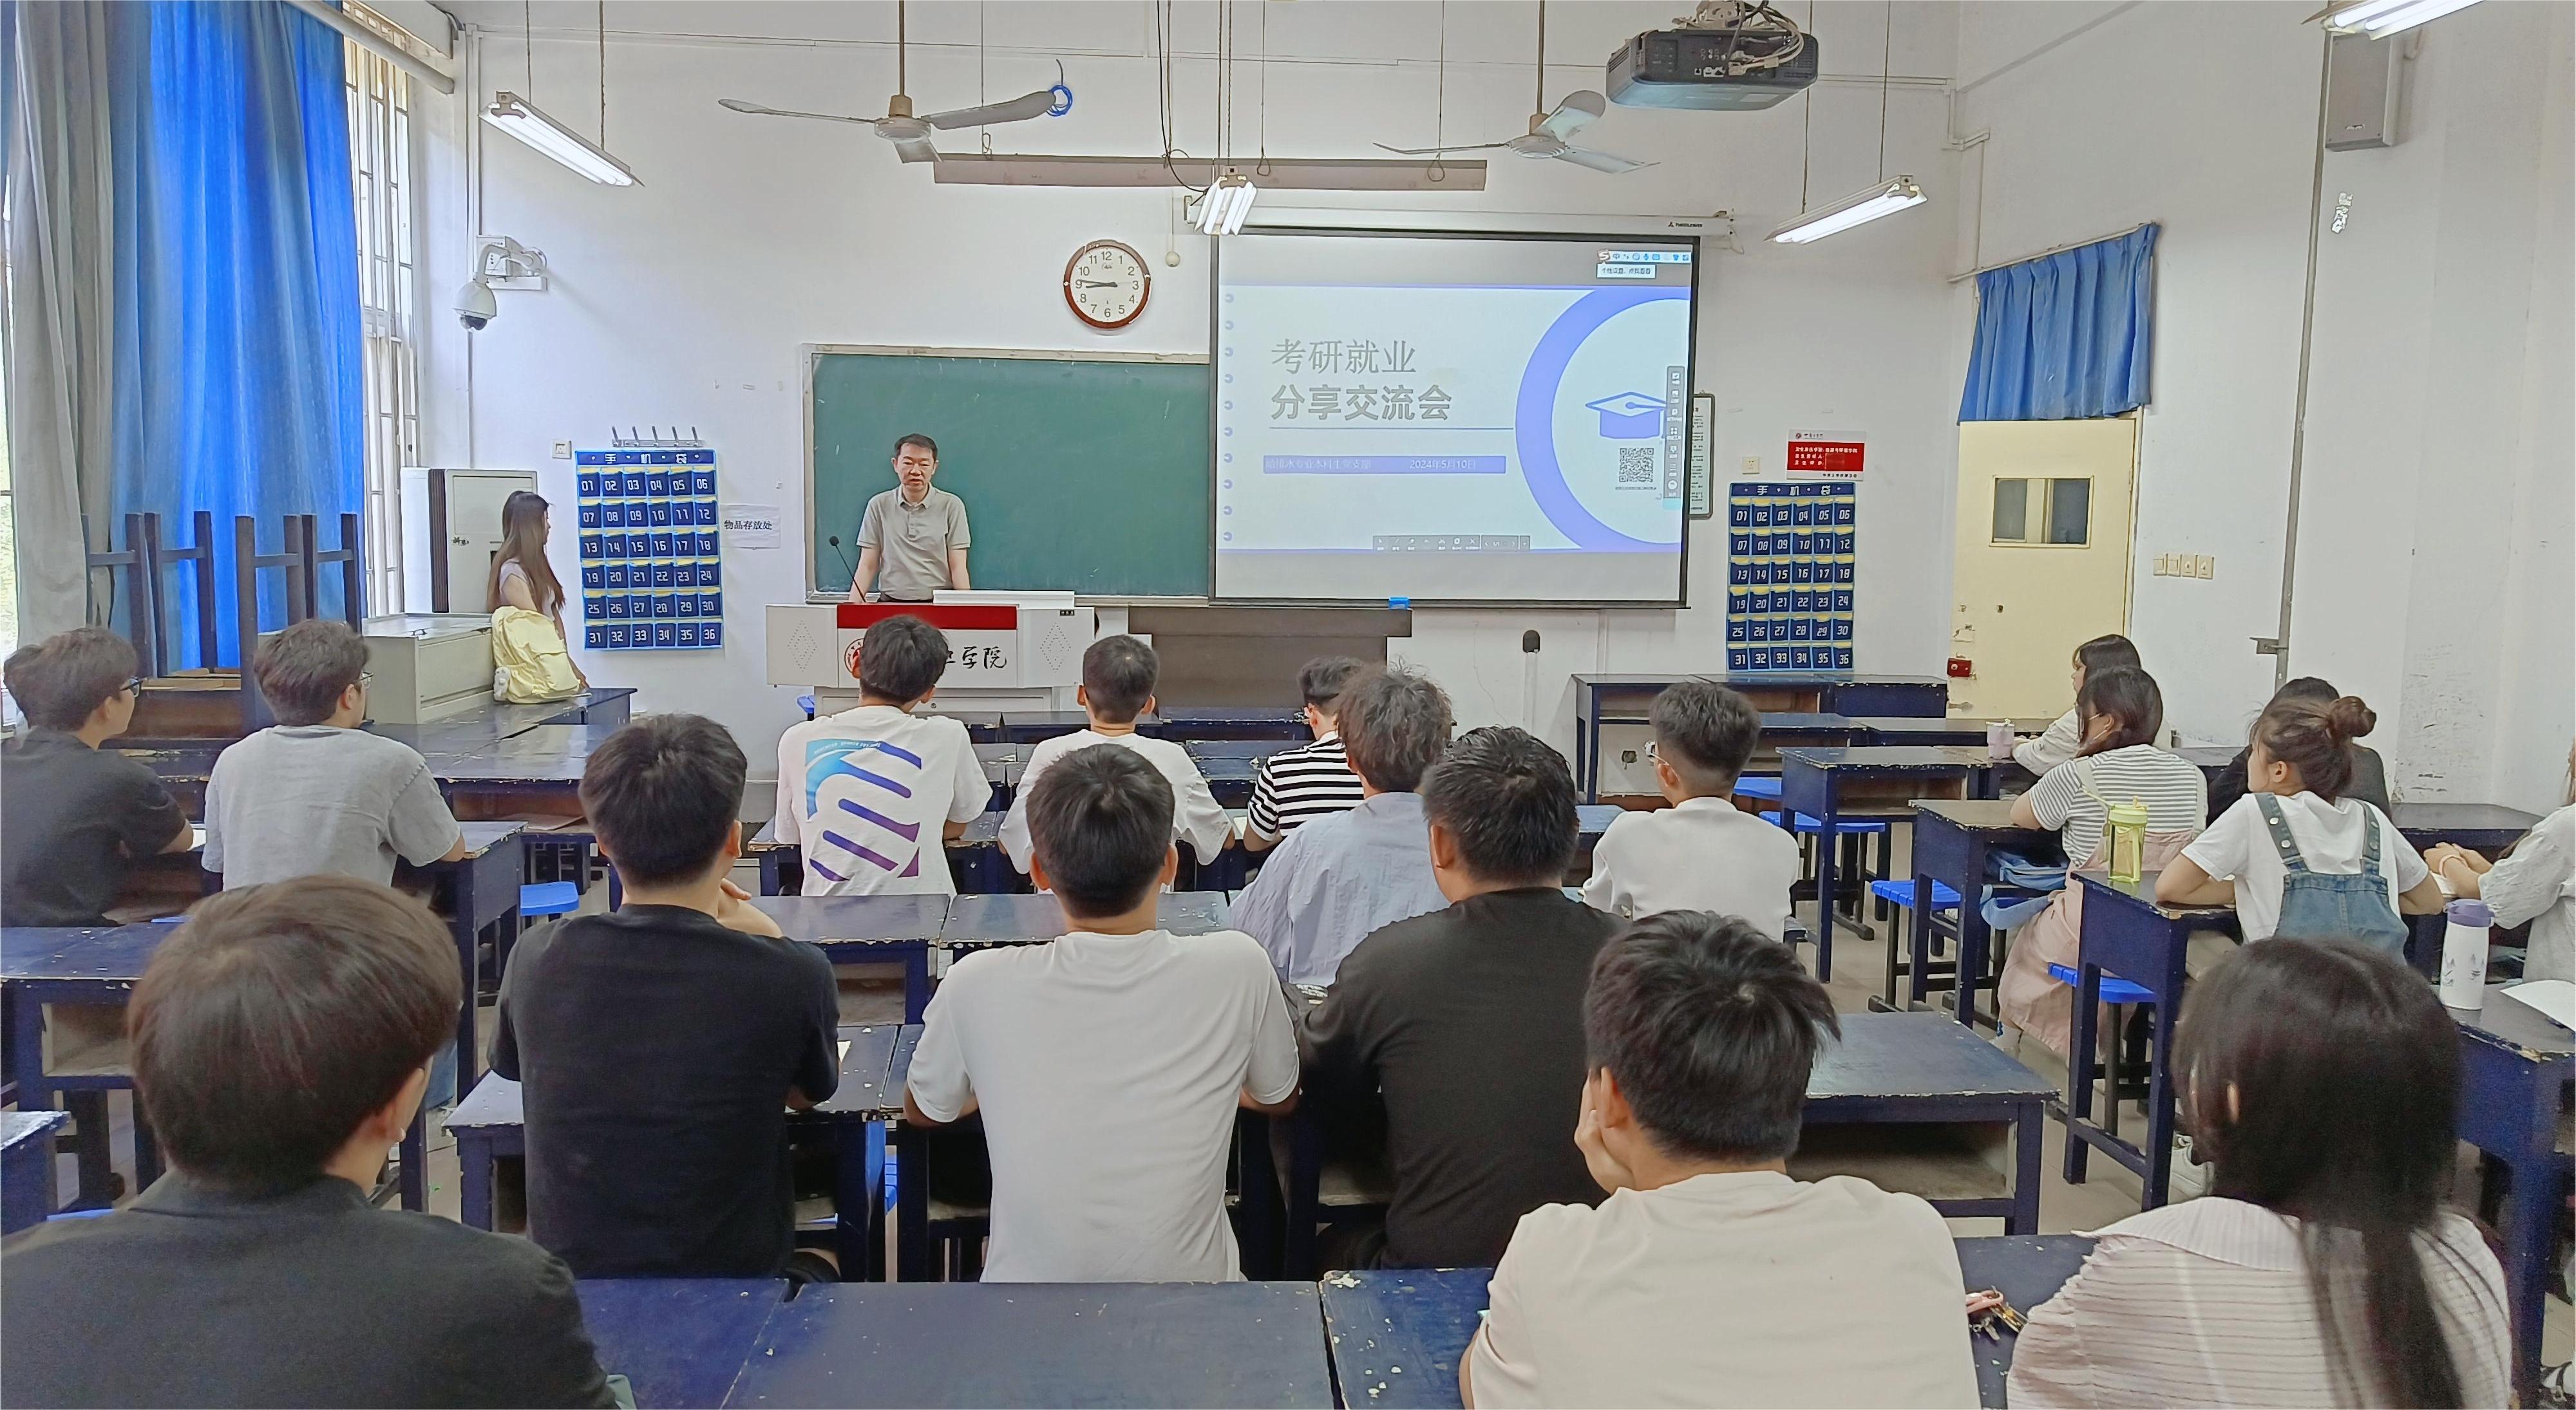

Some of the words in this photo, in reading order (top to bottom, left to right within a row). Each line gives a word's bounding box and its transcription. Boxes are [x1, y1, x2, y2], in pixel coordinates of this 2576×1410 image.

[1089, 255, 1097, 264] 11
[1101, 251, 1112, 261] 12
[1119, 255, 1122, 264] 1
[1079, 266, 1090, 276] 10
[1128, 266, 1135, 276] 2
[1075, 279, 1083, 288] 9
[1132, 280, 1139, 290] 3
[1080, 294, 1086, 303] 8
[1129, 295, 1135, 303] 4
[1090, 304, 1097, 313] 7
[1104, 308, 1111, 317] 6
[1119, 305, 1125, 314] 5
[1271, 339, 1417, 375] 考研就业
[1271, 384, 1452, 420] 分享交流会
[581, 480, 594, 491] 01
[605, 480, 618, 491] 02
[627, 480, 639, 491] 03
[650, 480, 663, 491] 04
[672, 479, 685, 491] 05
[696, 478, 708, 489] 06
[583, 512, 594, 523] 07
[606, 511, 619, 522] 08
[629, 510, 642, 521] 09
[652, 510, 665, 522] 10
[676, 509, 688, 520] 11
[698, 509, 711, 520] 12
[1736, 511, 1748, 522] 01
[1756, 511, 1768, 522] 02
[1777, 511, 1788, 522] 03
[1798, 511, 1808, 522] 04
[1818, 509, 1830, 520] 05
[1839, 509, 1850, 520] 06
[724, 520, 773, 530] 物品存放处
[584, 542, 598, 553] 13
[607, 542, 620, 553] 14
[631, 541, 644, 552] 15
[654, 540, 667, 551] 16
[676, 540, 688, 551] 17
[699, 540, 711, 550] 18
[1737, 540, 1748, 550] 07
[1757, 541, 1768, 550] 08
[1777, 539, 1788, 550] 09
[1799, 540, 1810, 550] 10
[1819, 538, 1830, 550] 11
[1840, 538, 1850, 550] 12
[586, 572, 598, 583] 19
[609, 571, 622, 582] 20
[633, 571, 645, 582] 21
[655, 571, 668, 581] 22
[677, 571, 690, 582] 23
[700, 570, 712, 581] 24
[1738, 570, 1748, 580] 13
[1756, 570, 1766, 580] 14
[1777, 569, 1788, 580] 15
[1798, 568, 1809, 578] 16
[1819, 569, 1830, 578] 17
[1839, 569, 1850, 579] 18
[587, 604, 600, 614] 25
[610, 603, 623, 614] 26
[633, 602, 645, 613] 27
[655, 603, 668, 613] 28
[680, 601, 692, 612] 29
[701, 601, 714, 611] 30
[1736, 599, 1746, 610] 19
[1756, 599, 1767, 609] 20
[1776, 597, 1787, 608] 21
[1797, 597, 1809, 607] 22
[1817, 597, 1829, 607] 23
[1838, 596, 1849, 606] 24
[588, 632, 601, 643] 31
[611, 630, 623, 642] 32
[634, 630, 647, 641] 33
[658, 629, 670, 641] 34
[680, 629, 693, 641] 35
[703, 628, 715, 639] 36
[1732, 627, 1744, 637] 25
[1754, 626, 1765, 637] 26
[1774, 626, 1785, 636] 27
[1795, 625, 1806, 635] 28
[1816, 626, 1828, 637] 29
[1837, 625, 1849, 635] 30
[1735, 654, 1746, 665] 31
[1755, 653, 1766, 664] 32
[1776, 652, 1787, 664] 33
[1796, 652, 1807, 663] 34
[1817, 652, 1828, 664] 35
[1839, 653, 1849, 664] 36
